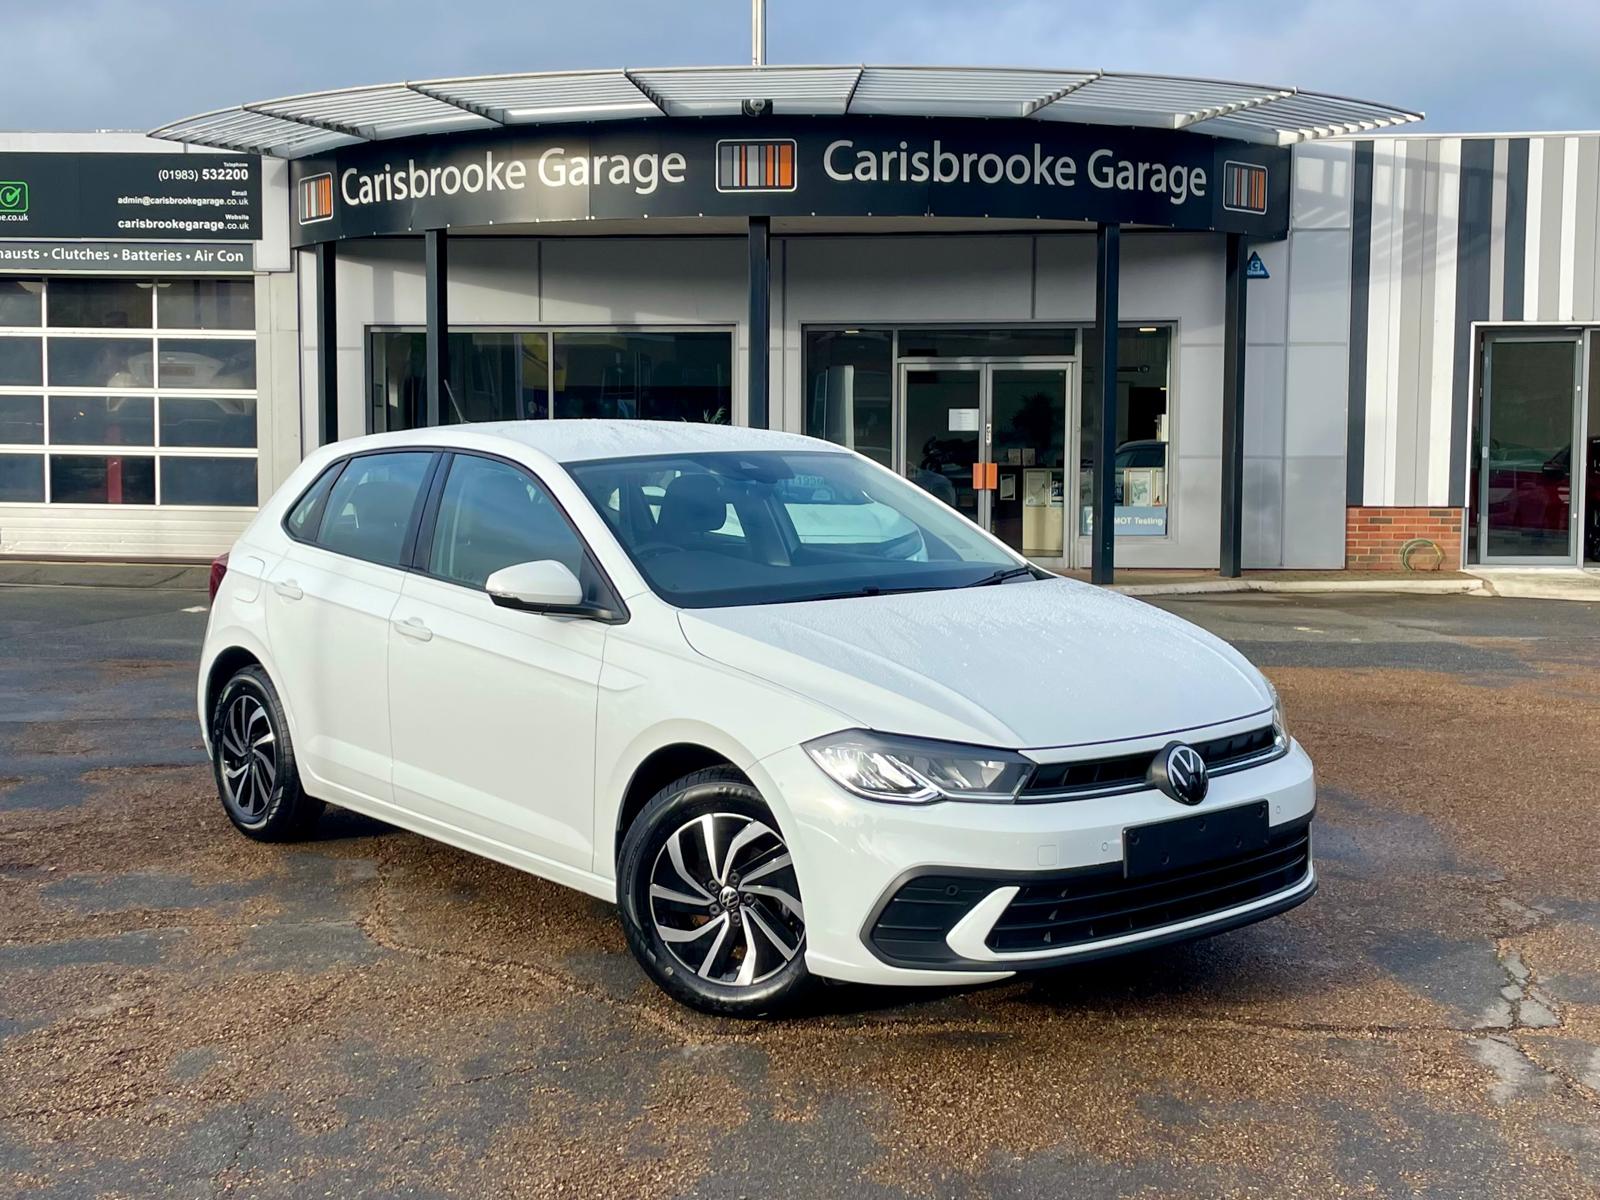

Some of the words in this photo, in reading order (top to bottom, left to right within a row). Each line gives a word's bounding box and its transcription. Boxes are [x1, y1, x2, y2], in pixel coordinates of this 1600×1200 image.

[158, 169, 199, 182] (01983)
[202, 168, 249, 180] 532200
[340, 151, 527, 206] Carisbrooke
[538, 147, 687, 195] Garage
[822, 139, 1077, 188] Carisbrooke
[1087, 148, 1208, 205] Garage
[117, 195, 249, 207] admin@carisbrookegarage.co.uk
[0, 213, 29, 222] e.co.uk
[117, 218, 250, 231] carisbrookegarage.co.uk
[51, 247, 110, 261] Clutches
[122, 249, 183, 262] Batteries
[194, 249, 215, 262] Air
[217, 249, 244, 262] Con
